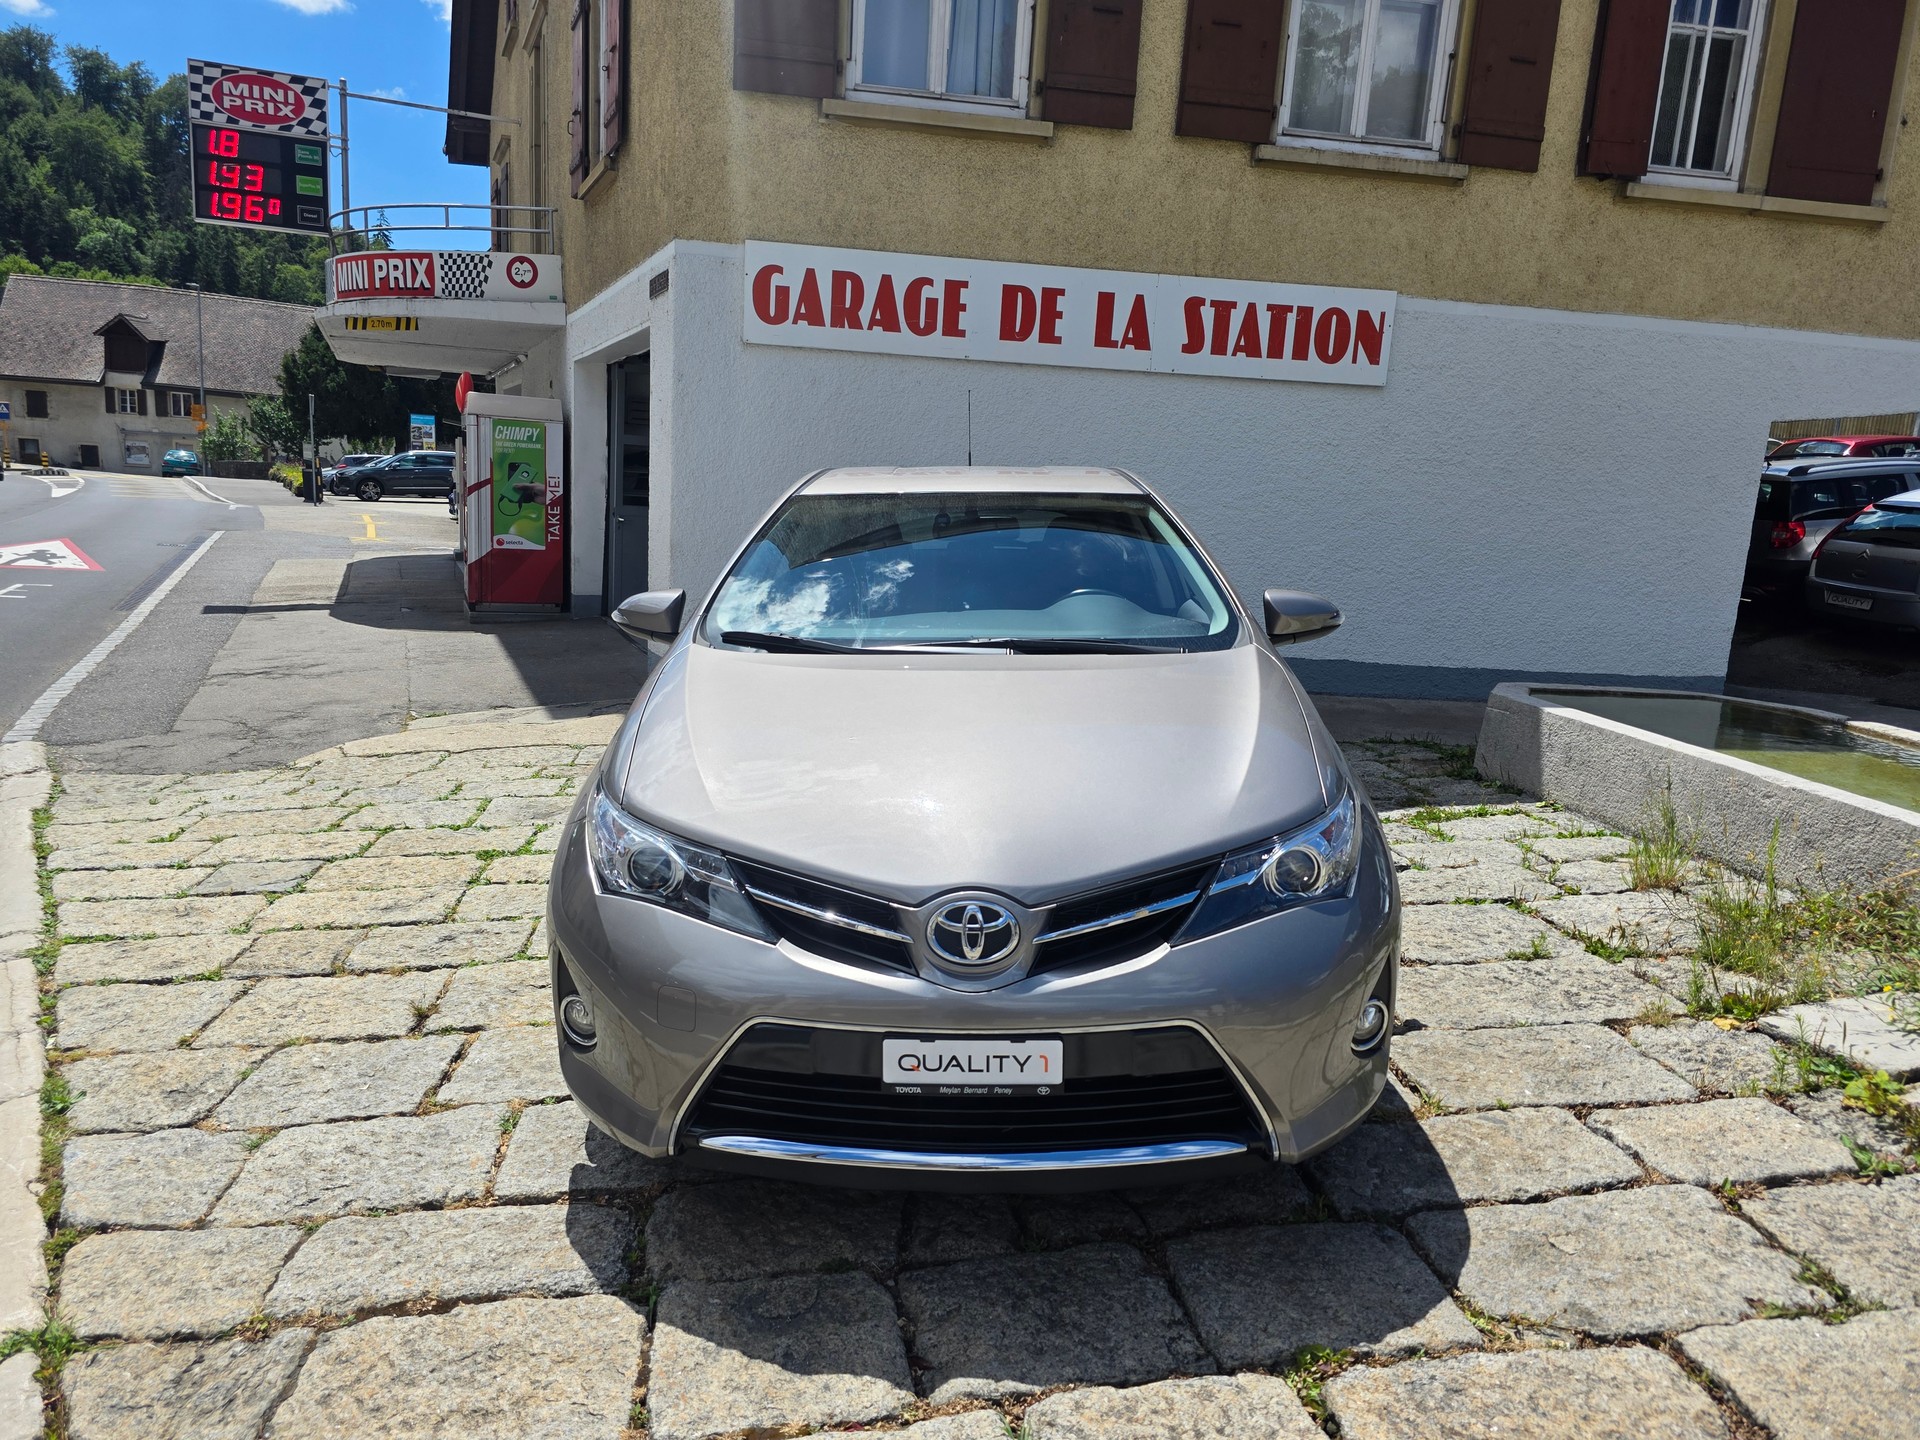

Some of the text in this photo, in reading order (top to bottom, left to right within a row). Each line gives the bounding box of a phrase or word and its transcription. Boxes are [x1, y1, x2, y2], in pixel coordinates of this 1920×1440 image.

[222, 80, 295, 103] MINI
[223, 96, 296, 118] PRIX
[337, 258, 431, 292] MINI PRIX
[751, 263, 1386, 366] GARAGE DE LA STATION
[495, 425, 540, 441] CHIMPY
[548, 476, 560, 542] TAKE ME!
[898, 1053, 1049, 1073] QUALITY 1
[895, 1086, 922, 1094] TOYOTA
[939, 1086, 961, 1095] Meylan
[963, 1086, 988, 1095] Bernard
